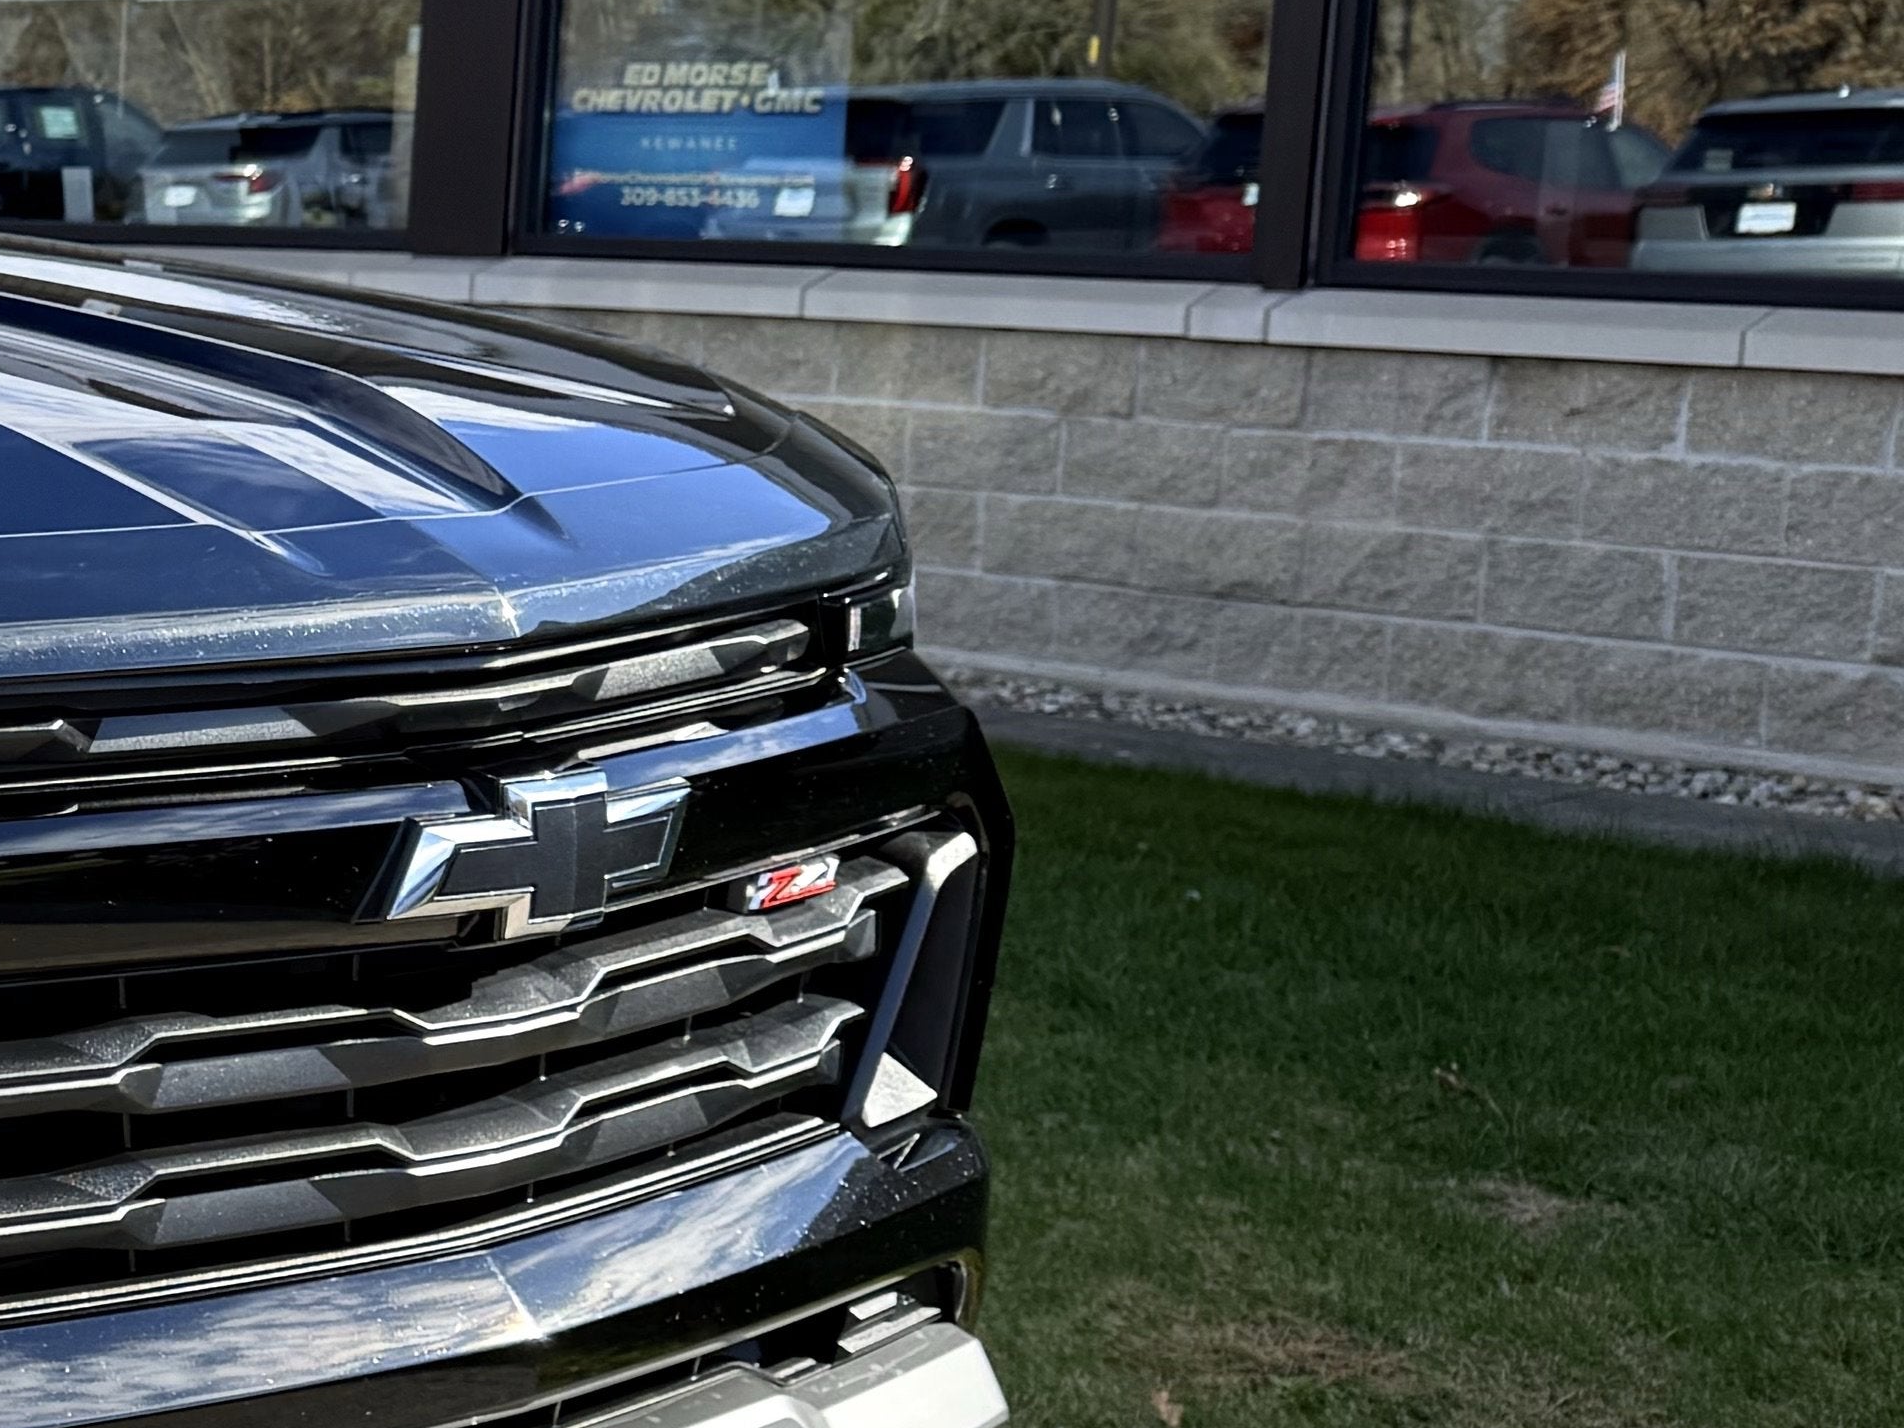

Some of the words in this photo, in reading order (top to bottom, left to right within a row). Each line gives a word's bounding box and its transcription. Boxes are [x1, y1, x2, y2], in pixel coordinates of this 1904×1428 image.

[622, 62, 662, 86] ED
[663, 62, 769, 86] MORSE
[642, 137, 738, 151] KEWANEE
